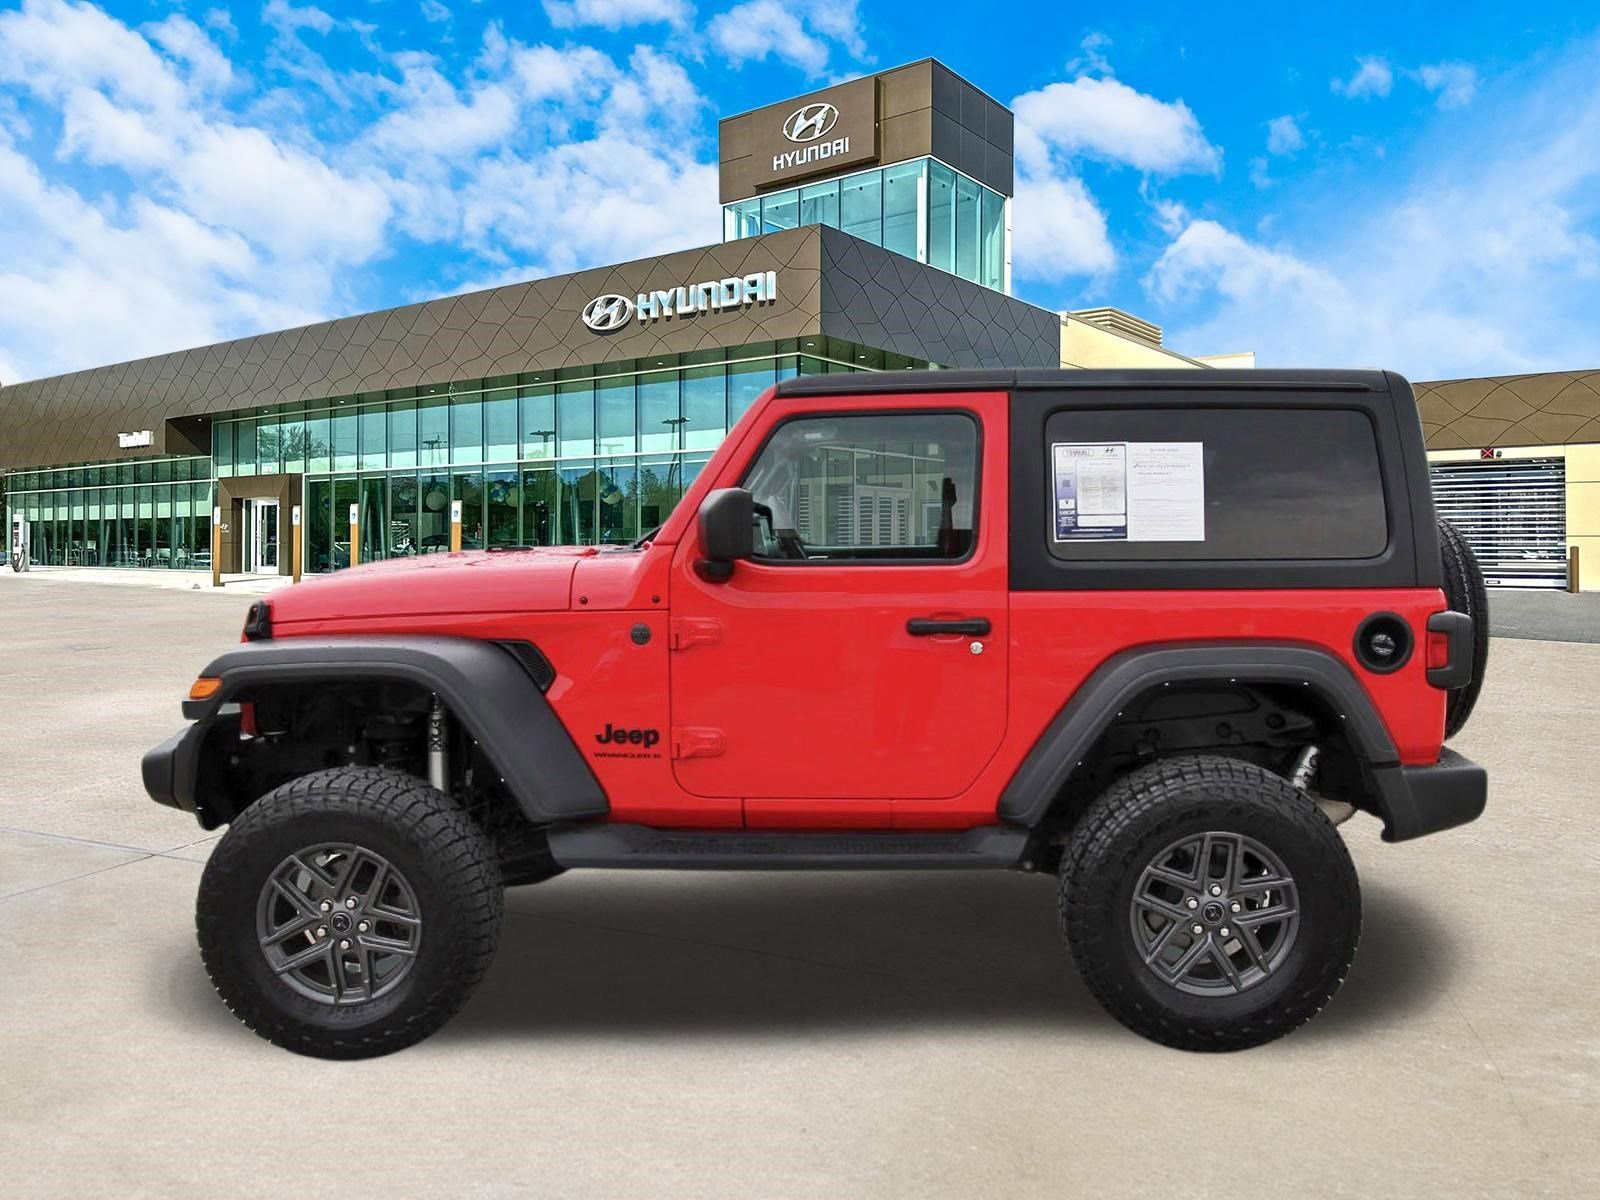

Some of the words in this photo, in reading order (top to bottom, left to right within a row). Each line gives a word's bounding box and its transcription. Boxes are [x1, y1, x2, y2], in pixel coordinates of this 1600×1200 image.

[773, 136, 850, 171] HYUNDAI
[636, 271, 777, 321] HYUNDAI
[595, 723, 660, 749] Jeep
